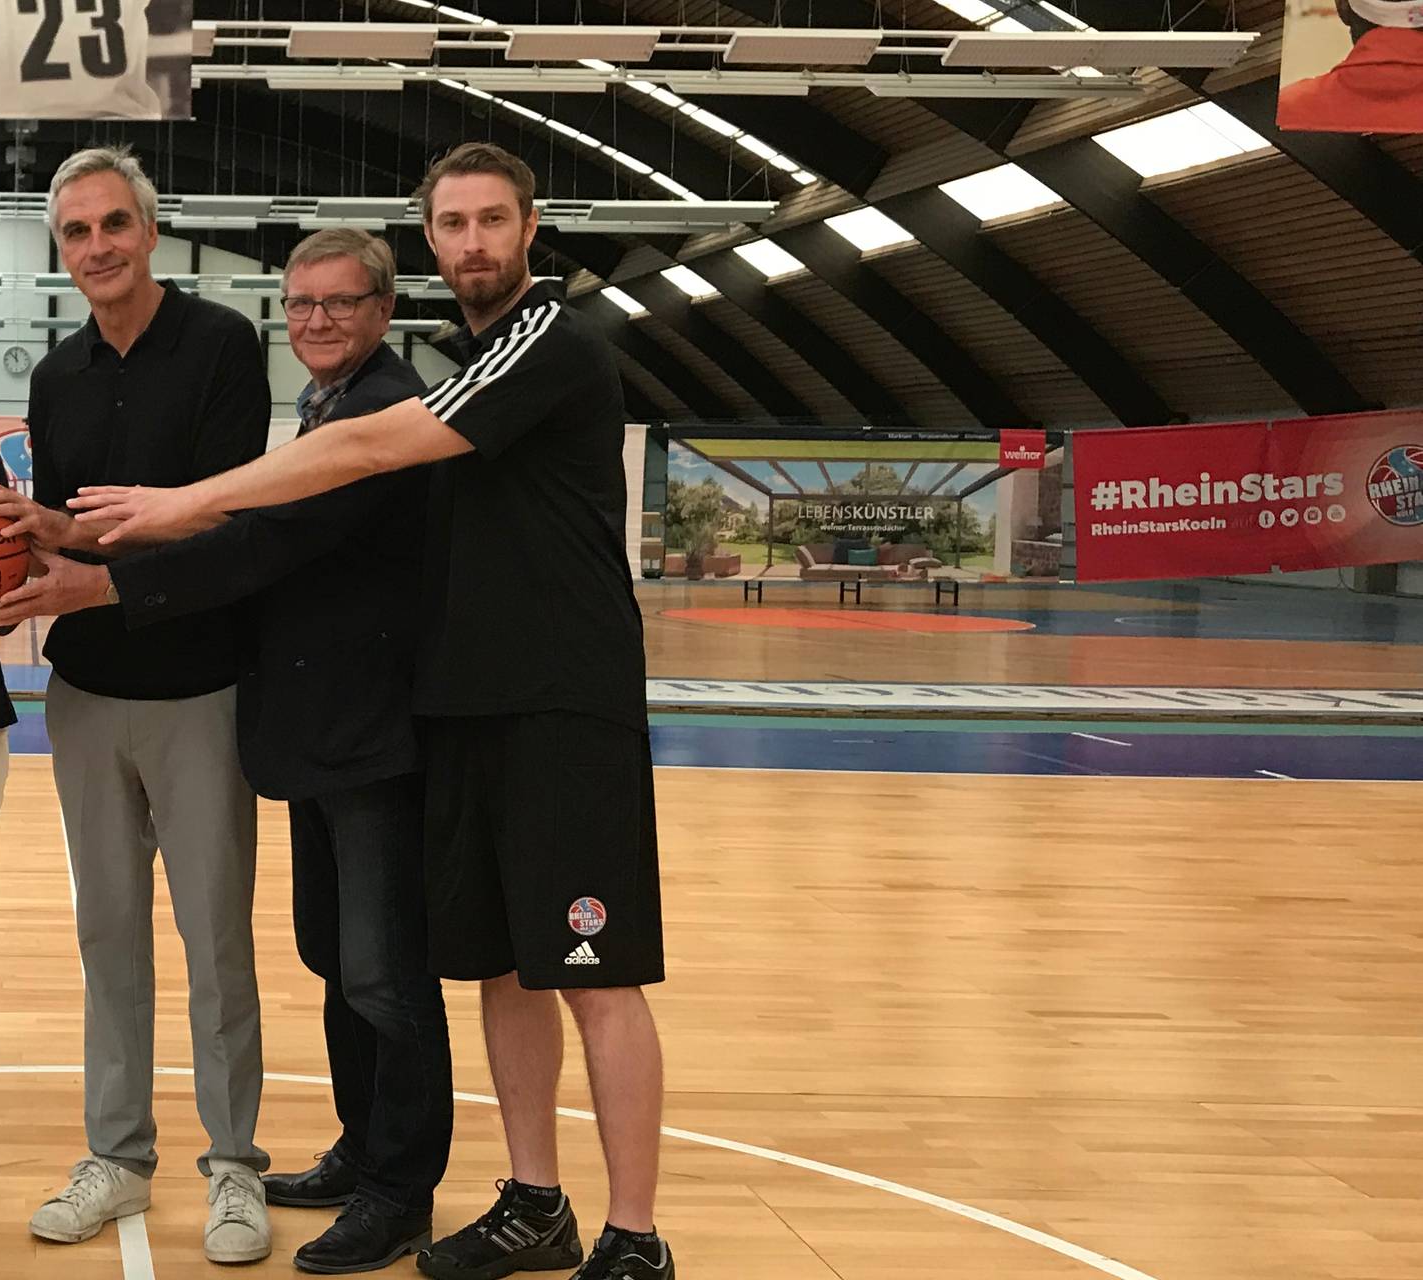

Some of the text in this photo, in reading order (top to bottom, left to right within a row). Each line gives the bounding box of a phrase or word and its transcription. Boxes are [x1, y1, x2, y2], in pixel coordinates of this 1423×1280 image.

[17, 0, 127, 81] 23
[1005, 446, 1041, 460] weinor
[1091, 472, 1344, 510] #RheinStars
[1368, 476, 1419, 499] RHEIN
[1396, 491, 1423, 510] STA
[798, 503, 935, 519] LEBENSKÜNSTLER
[1091, 517, 1226, 536] RheinStarsKoeln
[580, 919, 604, 928] STARS
[564, 955, 600, 965] adidas
